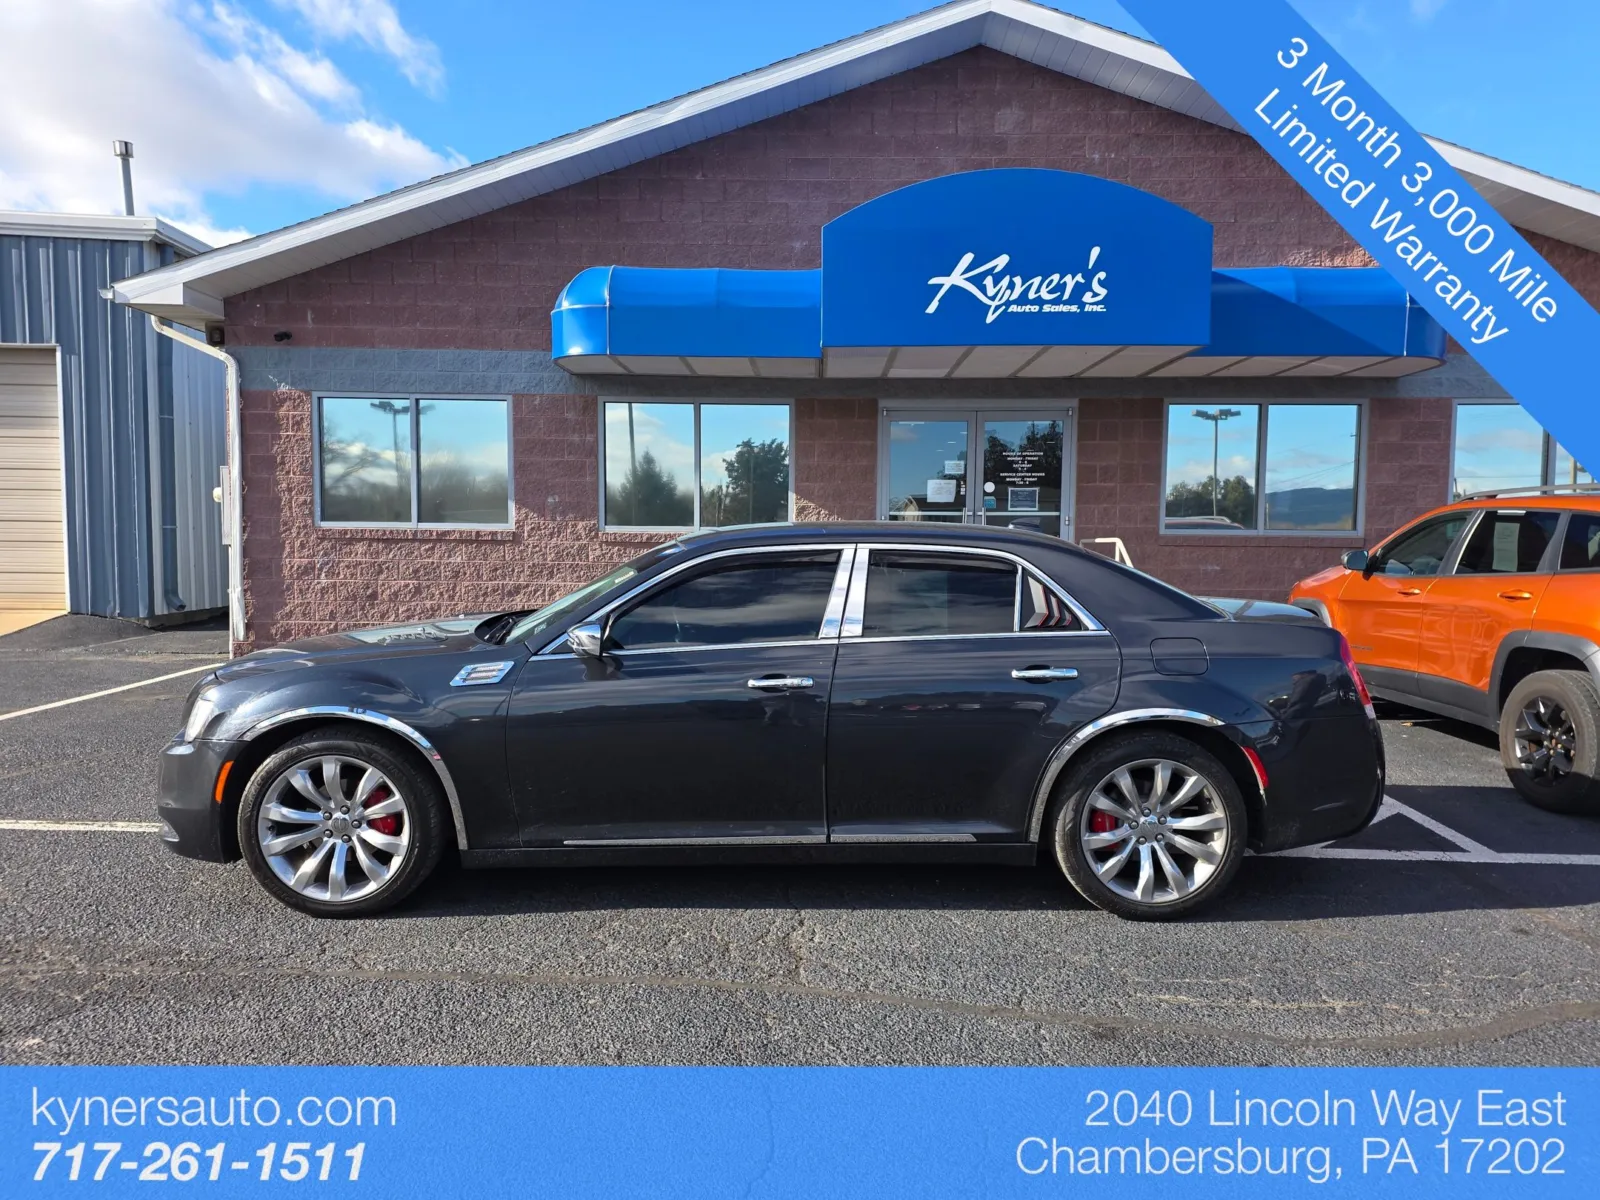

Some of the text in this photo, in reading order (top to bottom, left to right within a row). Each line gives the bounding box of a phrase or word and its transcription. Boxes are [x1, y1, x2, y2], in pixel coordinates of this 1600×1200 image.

[925, 246, 1108, 324] Kyner's
[1007, 304, 1106, 313] Auto Sales, Inc.
